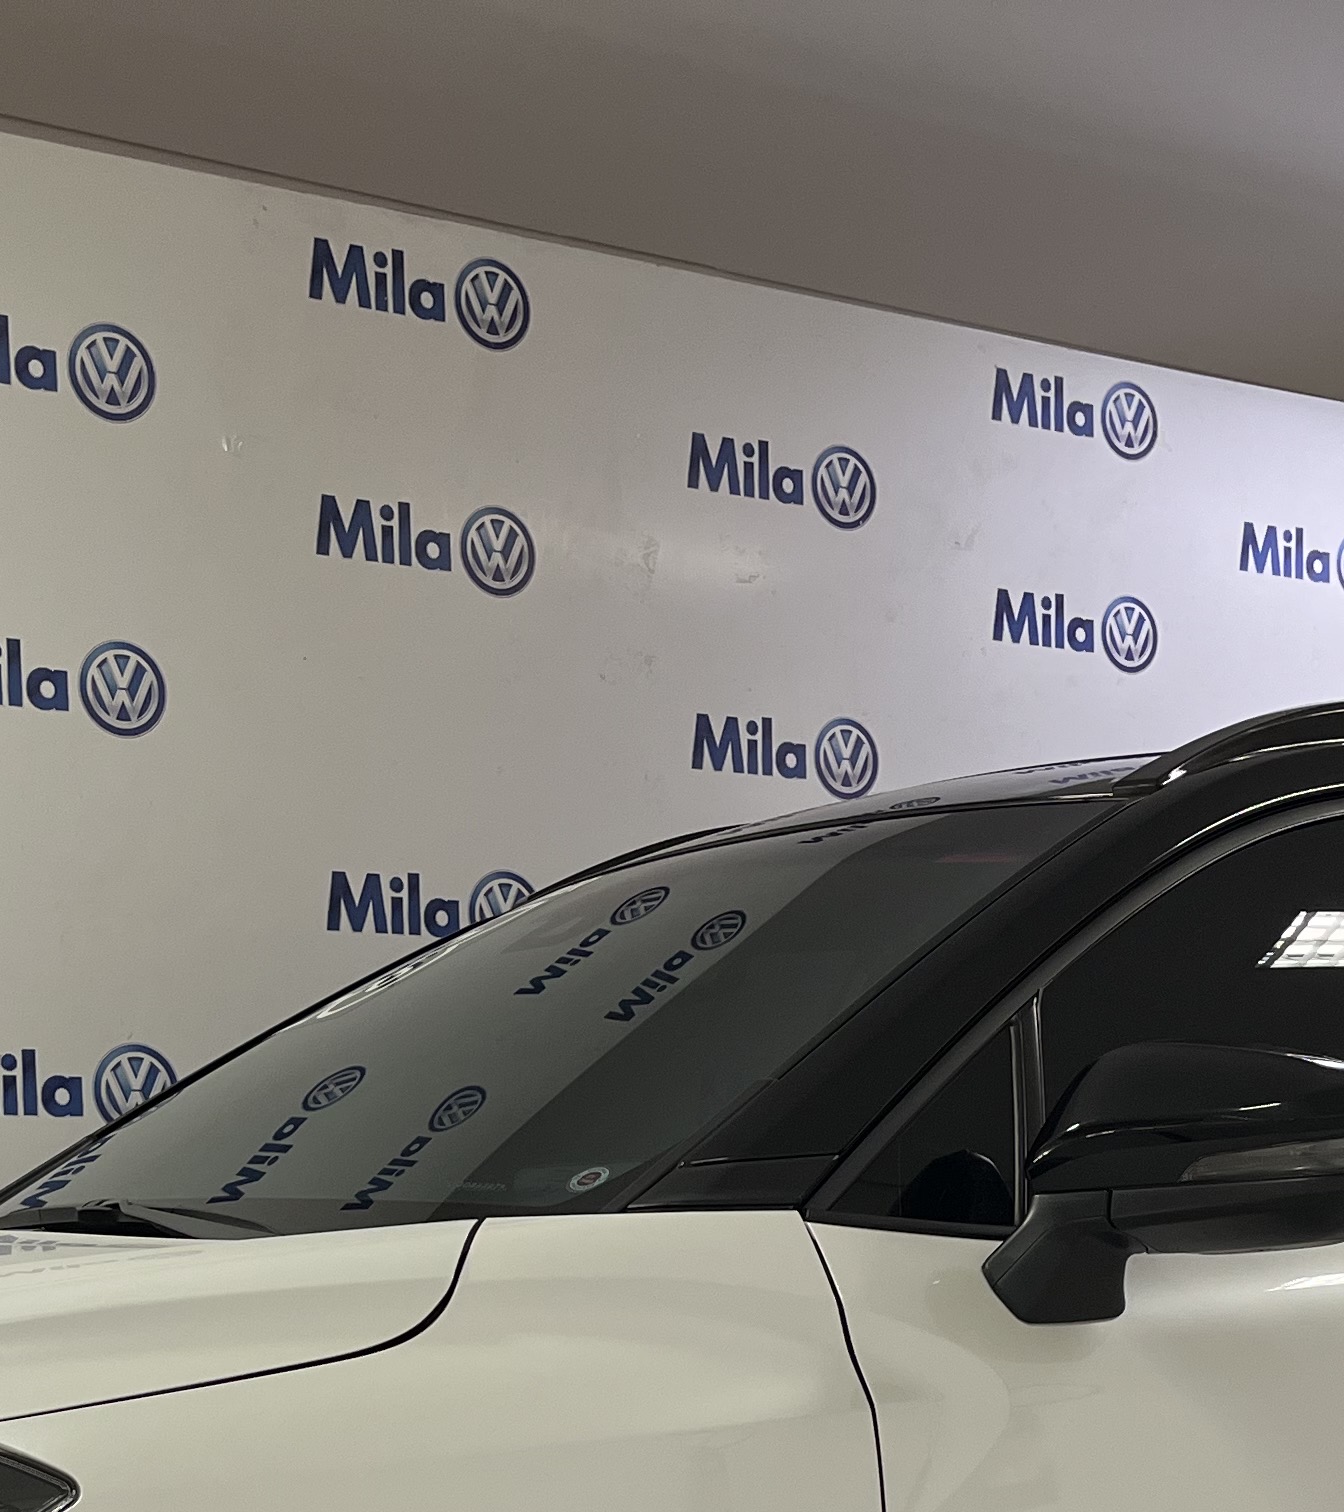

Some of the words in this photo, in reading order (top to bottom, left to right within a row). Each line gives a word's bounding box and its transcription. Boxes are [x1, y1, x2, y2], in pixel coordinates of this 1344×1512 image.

[309, 238, 445, 322] Mila
[459, 265, 525, 345] VW
[74, 331, 150, 416] VW
[992, 367, 1093, 437] Mila
[1105, 387, 1154, 454] VW
[688, 432, 803, 505] Mila
[816, 452, 871, 523] VW
[316, 494, 451, 571] Mila
[465, 513, 530, 592] VW
[1240, 522, 1329, 583] Mila
[993, 588, 1094, 652] Mila
[1105, 601, 1154, 668] VW
[85, 648, 160, 731] VW
[692, 713, 806, 779] Mila
[818, 724, 874, 795] VW
[327, 871, 460, 938] Mila
